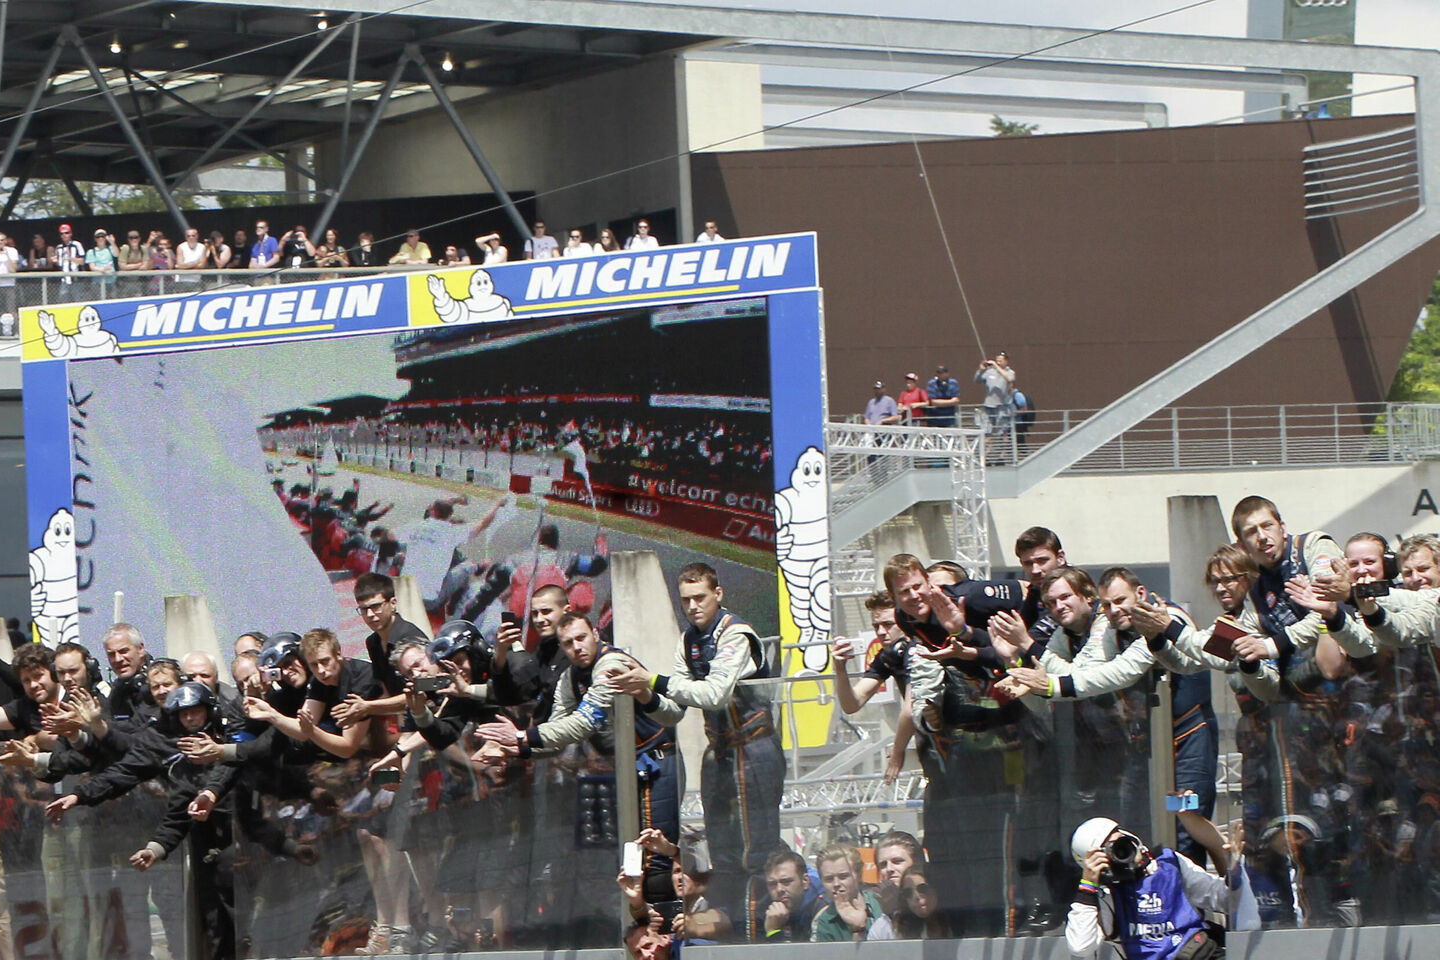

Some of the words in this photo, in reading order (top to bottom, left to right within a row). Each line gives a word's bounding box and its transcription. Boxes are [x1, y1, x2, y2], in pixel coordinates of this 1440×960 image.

[525, 241, 791, 300] MICHELIN
[131, 283, 384, 337] MICHELIN
[1128, 921, 1176, 936] MEDIA
